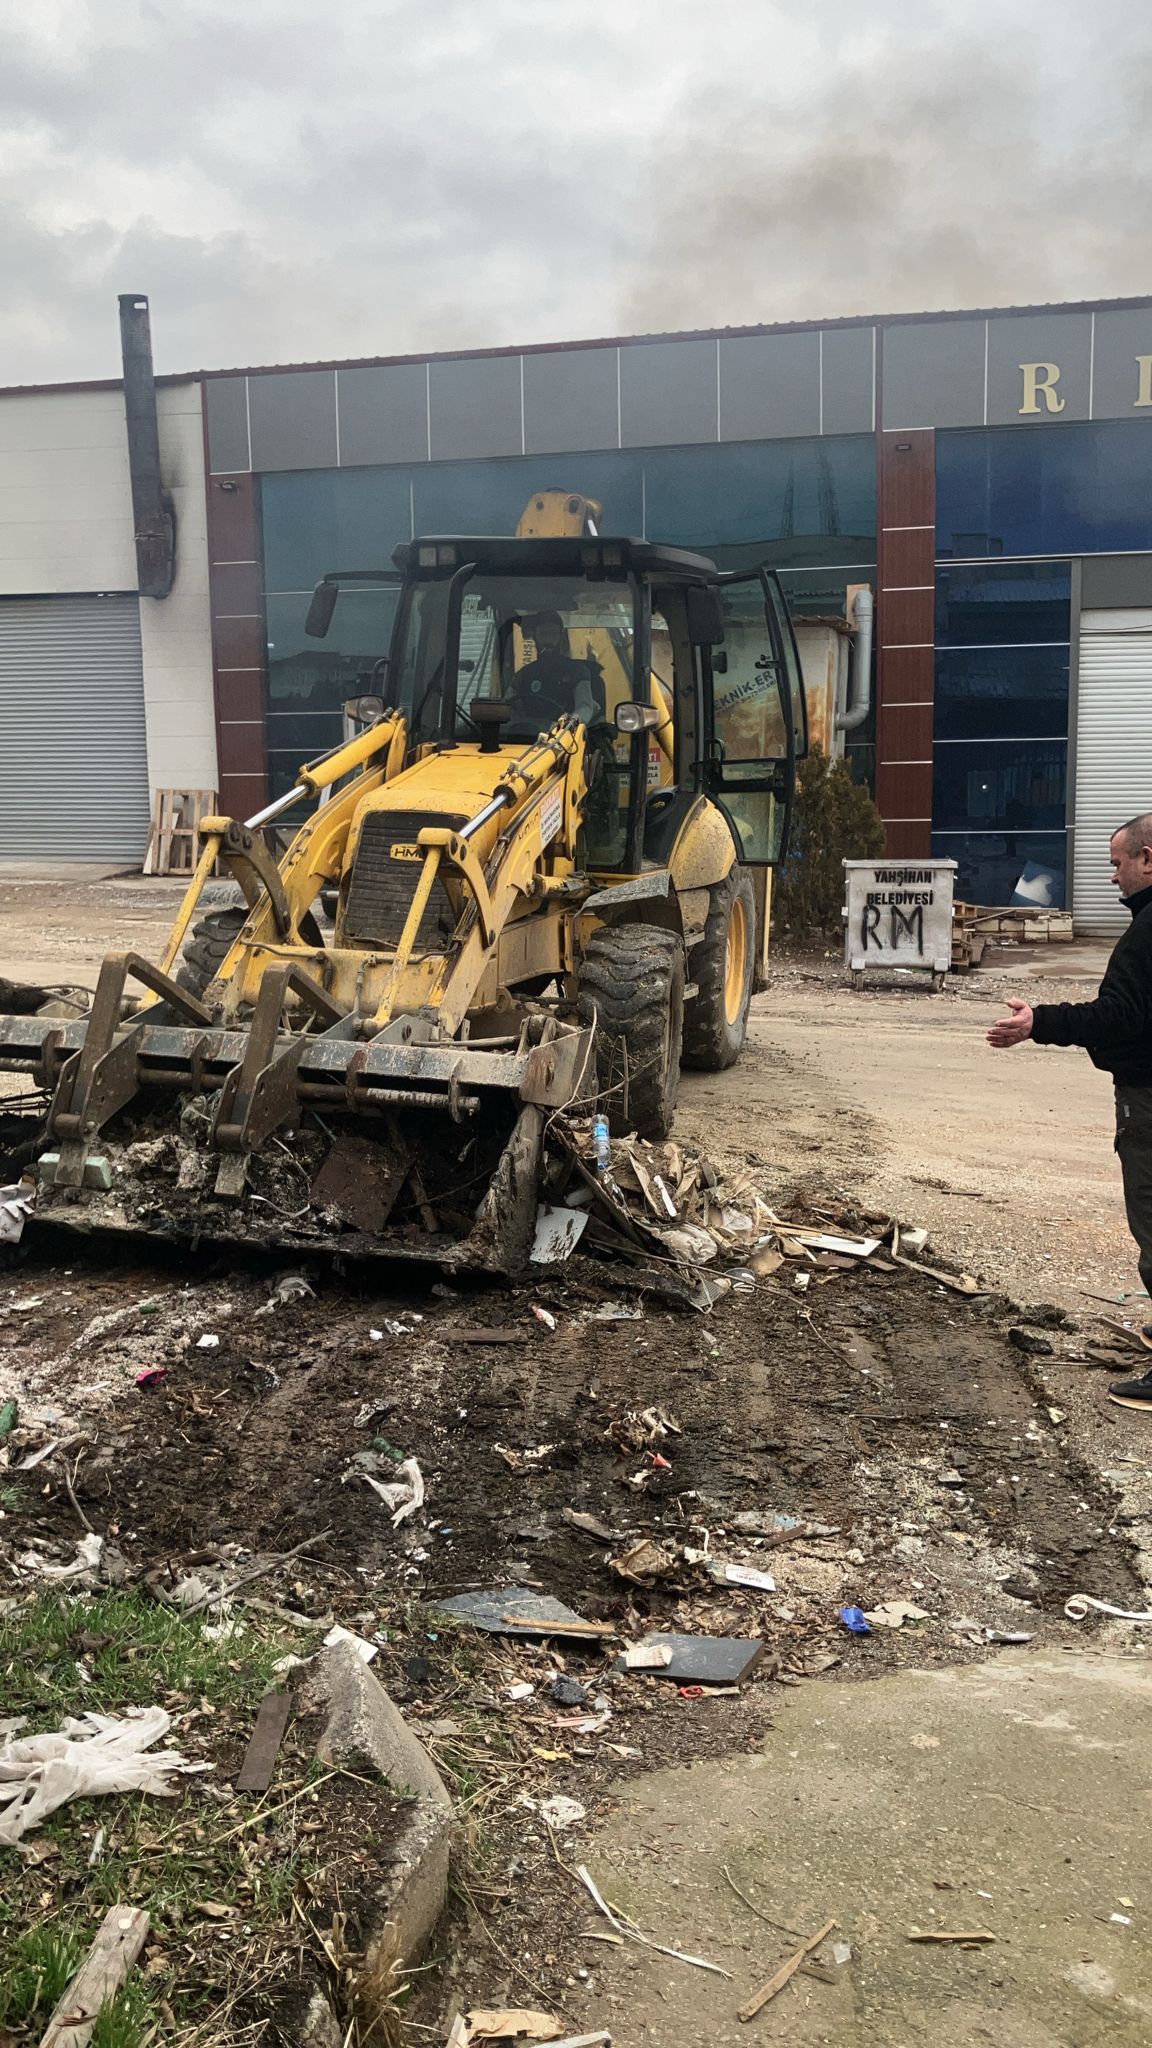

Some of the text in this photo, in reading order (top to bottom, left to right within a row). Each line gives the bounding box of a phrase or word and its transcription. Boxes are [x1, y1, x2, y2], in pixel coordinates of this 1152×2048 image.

[714, 671, 774, 711] EKNİK-ER
[394, 847, 419, 858] HM
[866, 890, 934, 906] BELEDİYESİ
[861, 905, 923, 956] RM
